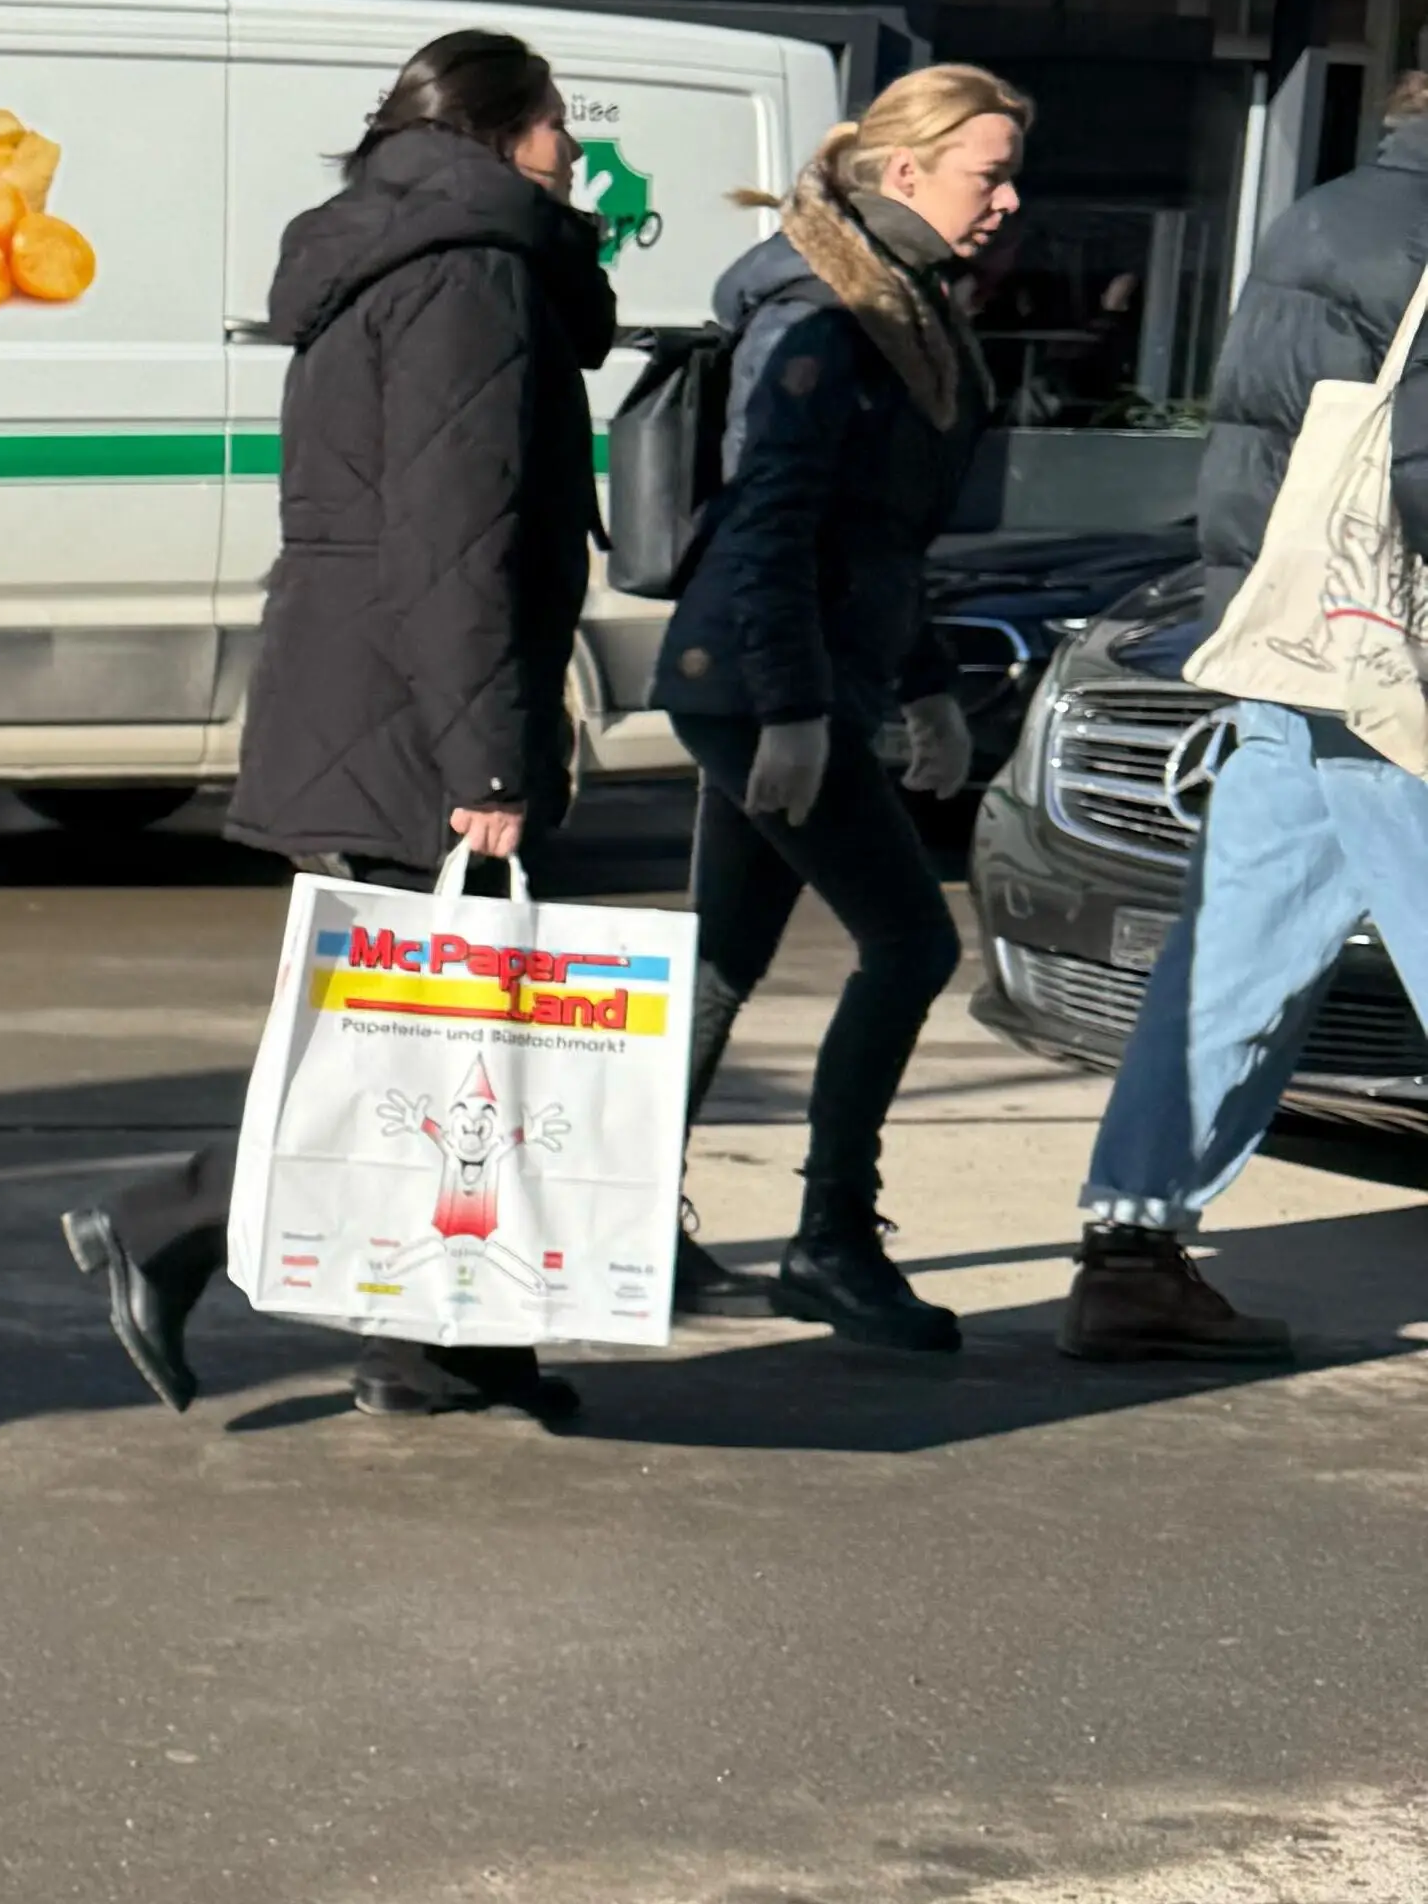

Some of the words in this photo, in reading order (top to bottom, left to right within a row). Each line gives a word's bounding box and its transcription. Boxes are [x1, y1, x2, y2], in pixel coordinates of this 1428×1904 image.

[565, 92, 620, 124] üse
[348, 925, 422, 973] Mc
[429, 932, 589, 991] Paper
[506, 980, 629, 1030] Land
[446, 1028, 484, 1043] und
